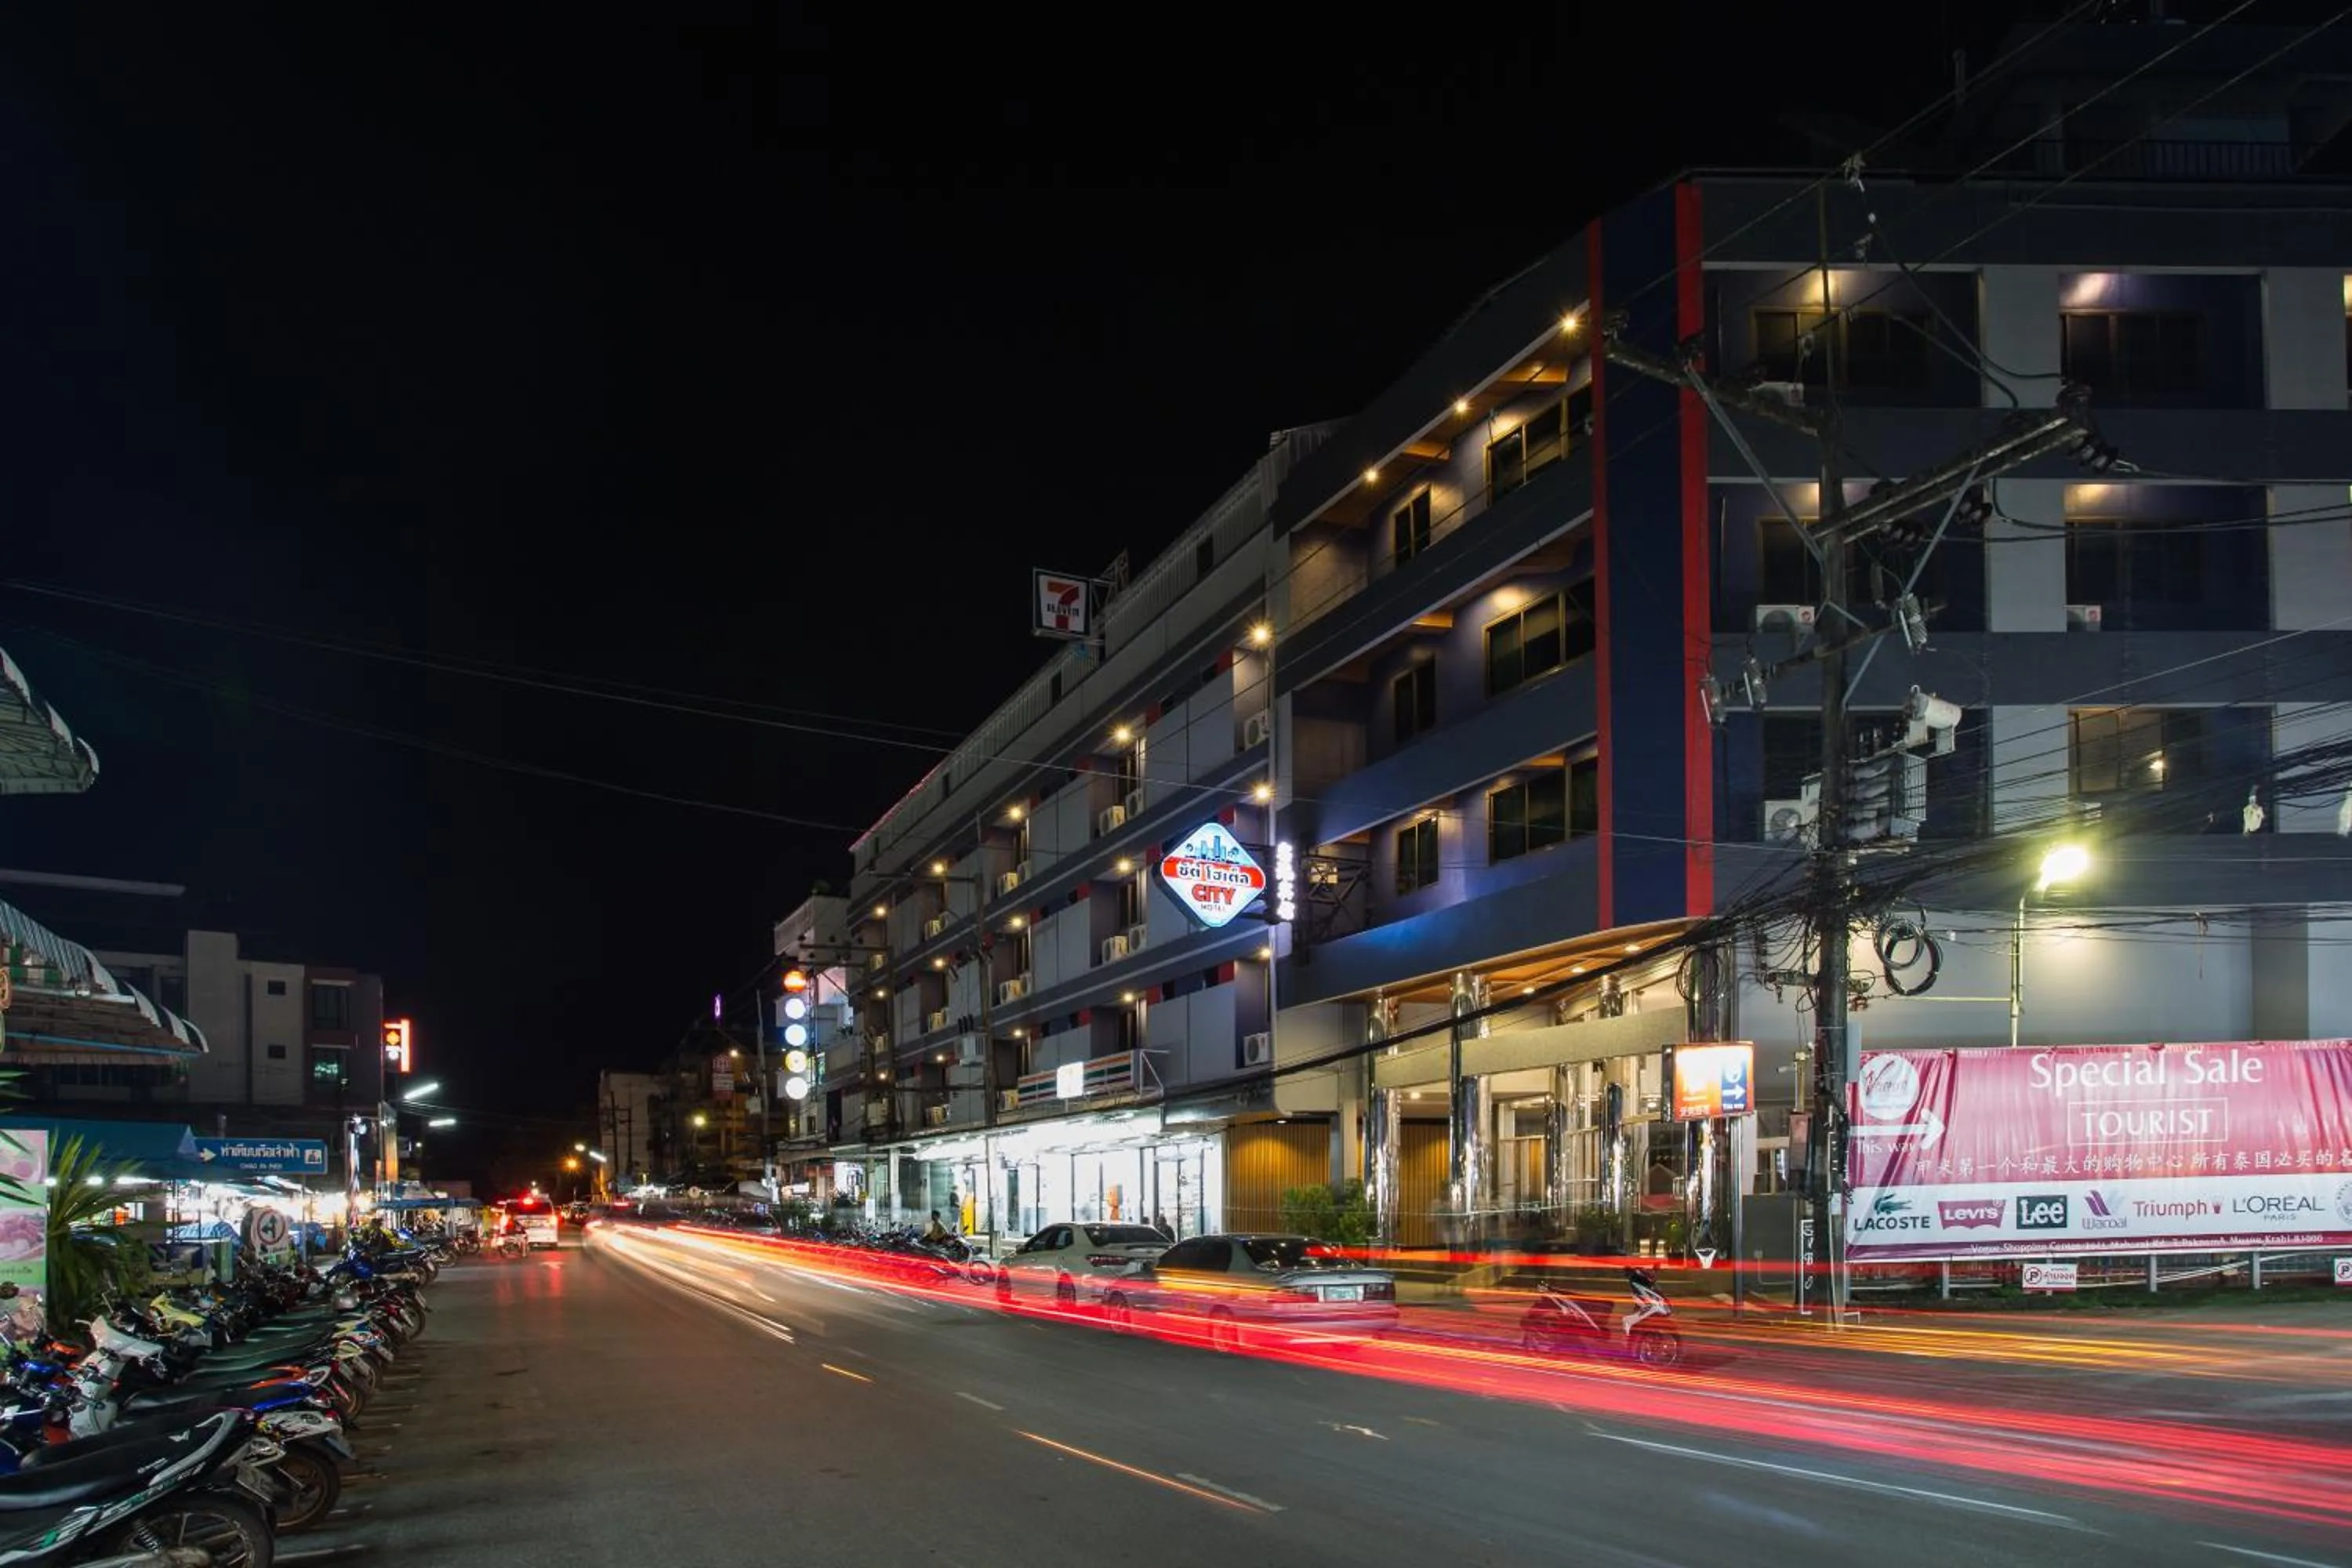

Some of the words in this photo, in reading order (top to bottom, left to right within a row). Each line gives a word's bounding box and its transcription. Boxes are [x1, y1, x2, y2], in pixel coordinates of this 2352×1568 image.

[1192, 883, 1236, 906] CITY
[2030, 1050, 2165, 1098] Special
[2183, 1048, 2264, 1085] Sale
[2080, 1108, 2213, 1138] TOURIST
[2020, 1199, 2064, 1225] Lee
[2132, 1199, 2207, 1220] Triumph
[2263, 1213, 2297, 1221] PARIS
[1853, 1216, 1930, 1231] LACOSTE
[2082, 1217, 2127, 1229] Wacoal
